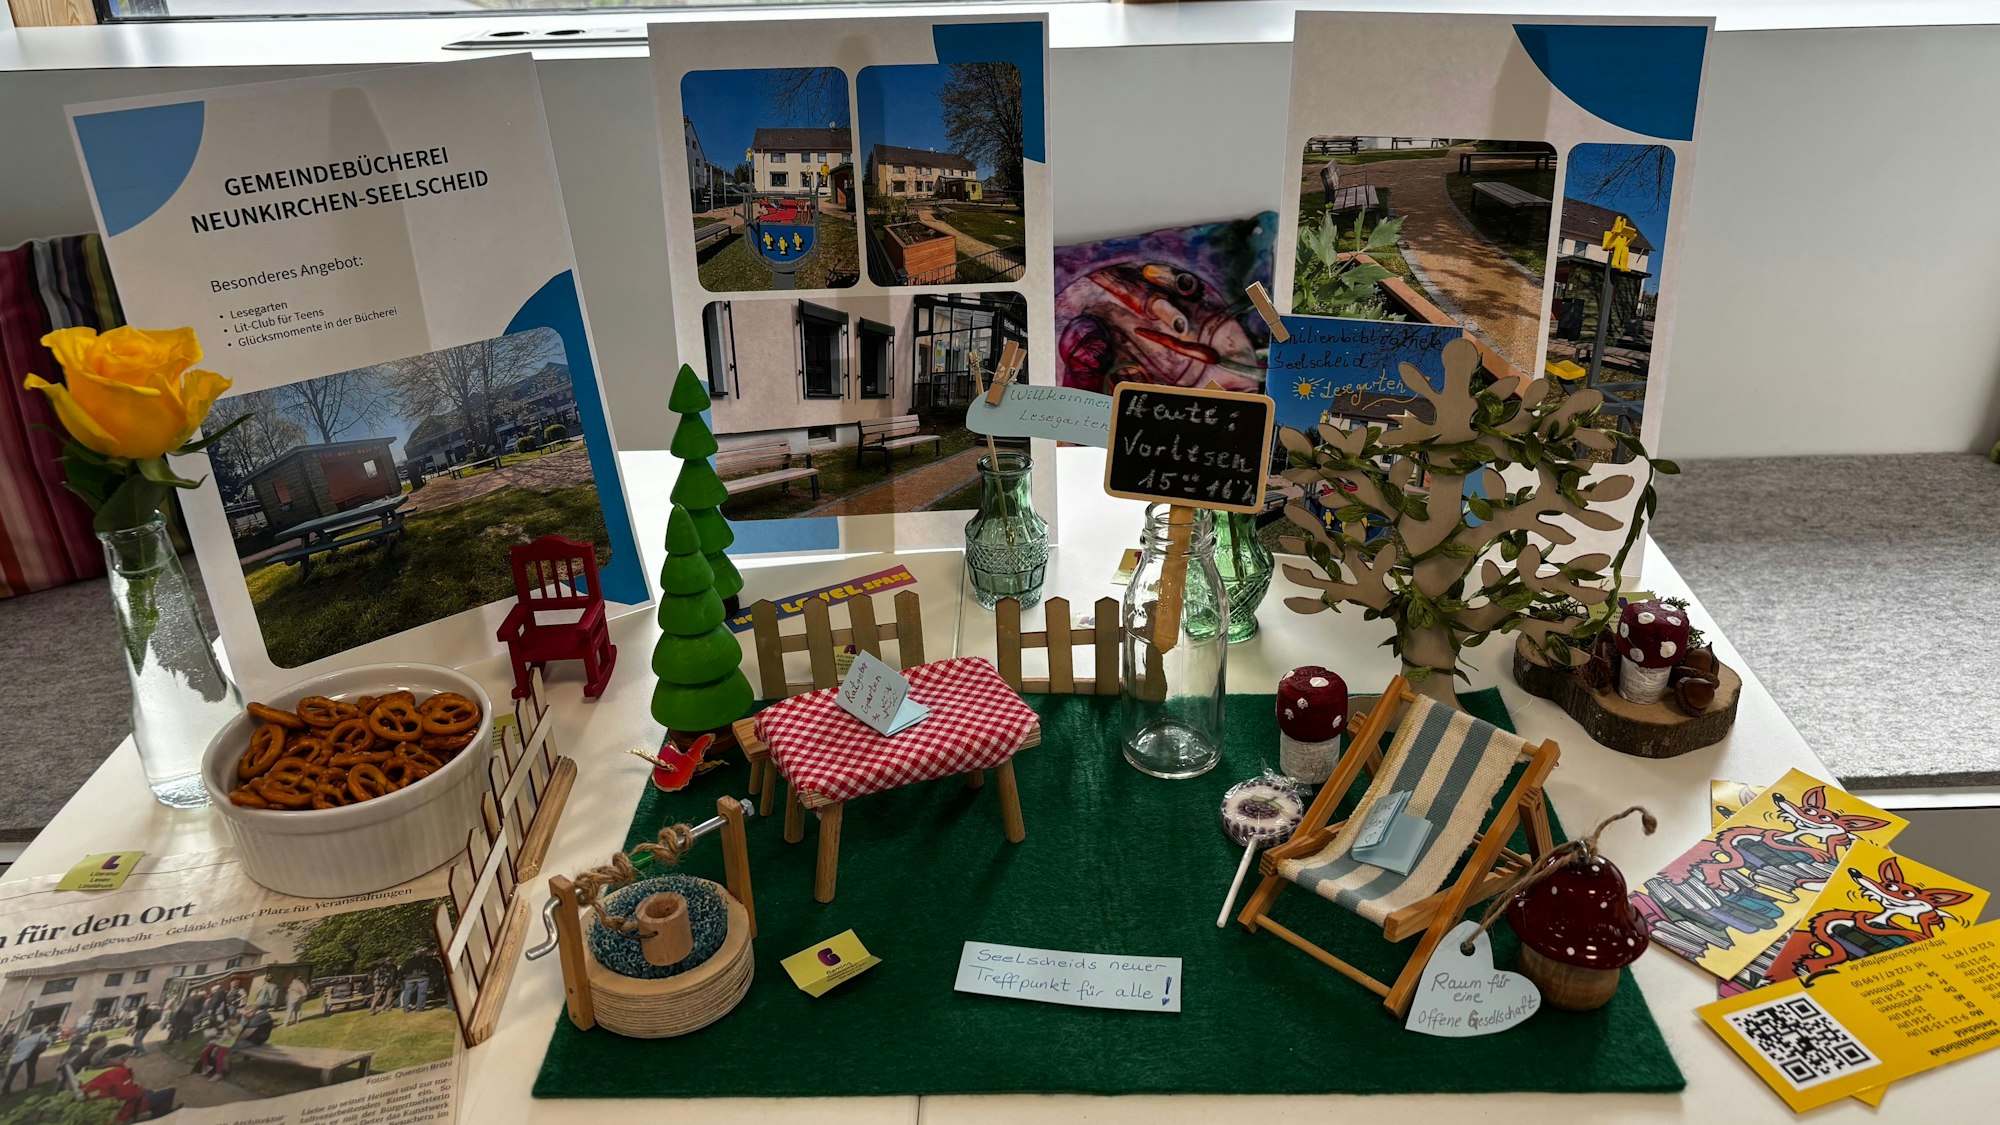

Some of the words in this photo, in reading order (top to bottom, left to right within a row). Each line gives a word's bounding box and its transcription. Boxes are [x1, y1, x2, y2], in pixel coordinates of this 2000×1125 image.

[224, 147, 449, 196] GEMEINDEBÜCHEREI
[191, 170, 489, 234] NEUNKIRCHEN-SEELSCHEID
[210, 268, 298, 293] Besonderes
[300, 256, 364, 277] Angebot:
[230, 302, 288, 319] Lesegarten
[234, 318, 276, 333] Lit-Club
[277, 314, 292, 326] für
[294, 308, 325, 321] Teens
[238, 323, 323, 347] Glücksmomente
[324, 320, 334, 330] in
[336, 316, 352, 328] der
[354, 306, 398, 323] Bücherei
[1320, 369, 1406, 405] Lesegarten
[1018, 409, 1110, 432] Lesegarten
[1124, 429, 1253, 473] Vorlesen
[11, 944, 80, 962] Seelscheid
[82, 933, 152, 950] eingeweiht
[166, 921, 218, 937] Gelände
[257, 904, 290, 918] Platz
[293, 903, 312, 914] für
[315, 889, 413, 910] Veranstaltungen
[15, 924, 66, 946] für
[72, 914, 131, 938] den
[140, 901, 197, 924] Ort
[977, 949, 1097, 970] Seelscheids
[1109, 961, 1167, 972] neuer
[1954, 961, 1969, 970] Uhr
[969, 964, 1071, 993] Treffpunkt
[1076, 980, 1104, 1000] für
[1431, 972, 1482, 992] Raum
[1487, 973, 1511, 994] für
[1963, 968, 1978, 978] Uhr
[1453, 991, 1483, 1003] eine
[1860, 979, 1906, 998] geschlossen
[1418, 1008, 1462, 1030] Offene
[1467, 994, 1538, 1031] Gesellschaft
[1870, 996, 1886, 1007] Uhr
[1878, 993, 1923, 1013] geschlossen
[1888, 1012, 1903, 1022] Uhr
[1896, 1020, 1911, 1030] Uhr
[1906, 1029, 1921, 1038] Uhr
[1929, 1028, 2000, 1056] amilienbibliothek
